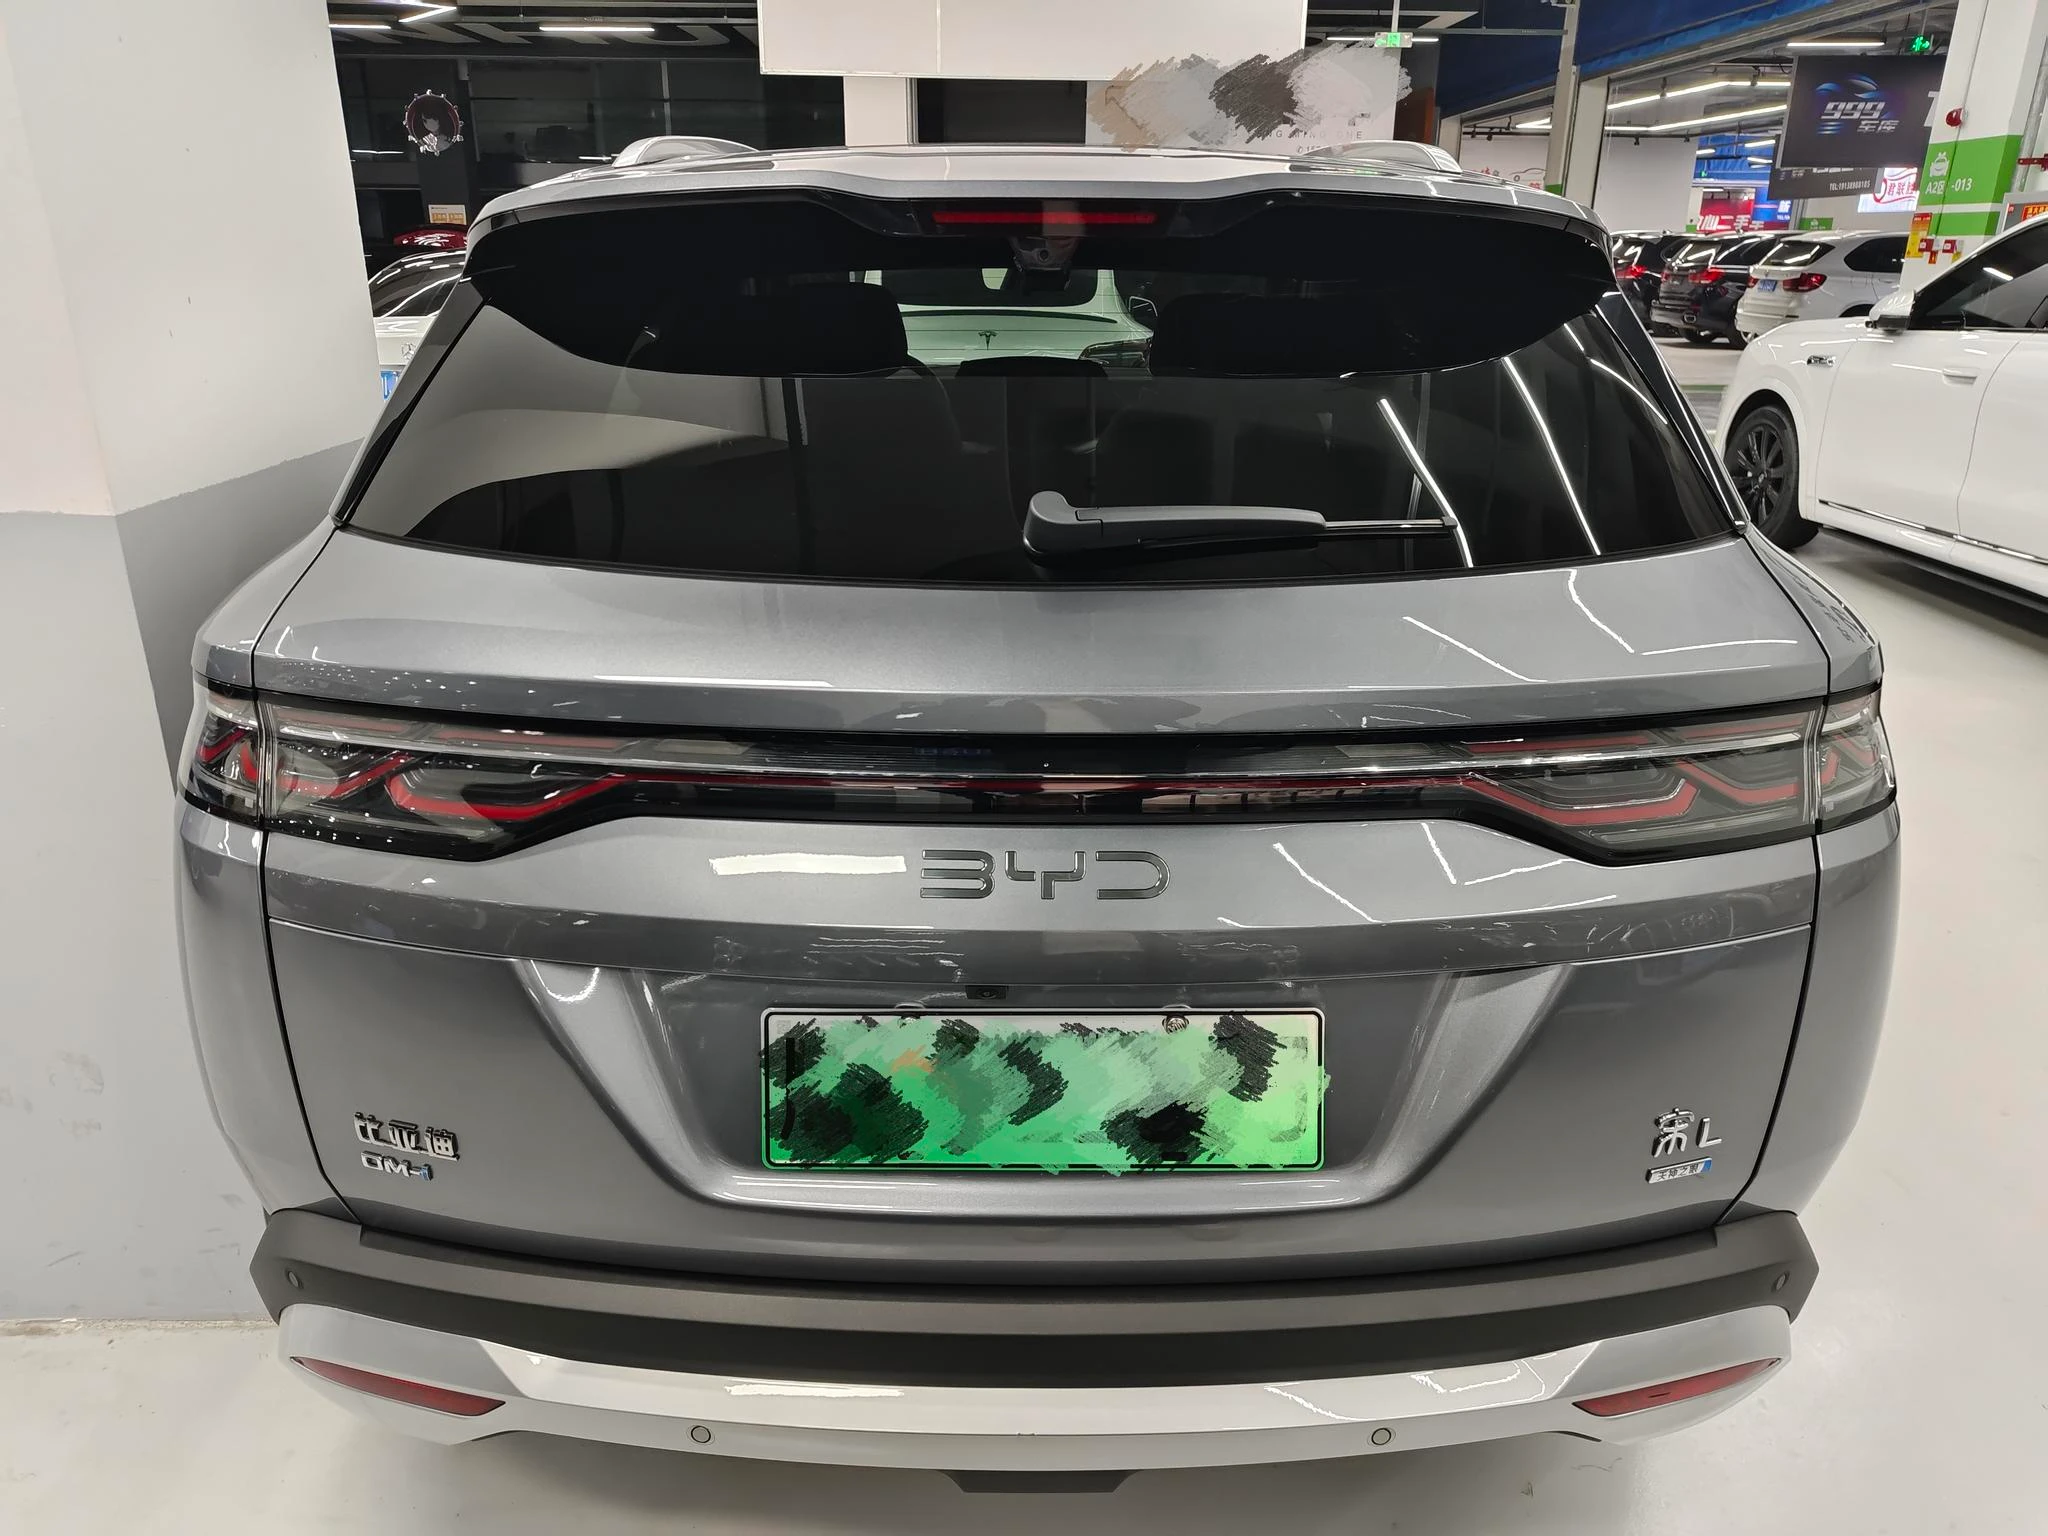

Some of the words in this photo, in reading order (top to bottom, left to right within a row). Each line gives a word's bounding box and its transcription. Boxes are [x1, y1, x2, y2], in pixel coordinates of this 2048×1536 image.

[1820, 101, 1886, 119] 999
[920, 850, 1171, 900] BYD
[354, 1112, 460, 1162] 比亚迪
[1652, 1107, 1695, 1158] 宋
[1696, 1117, 1722, 1149] L
